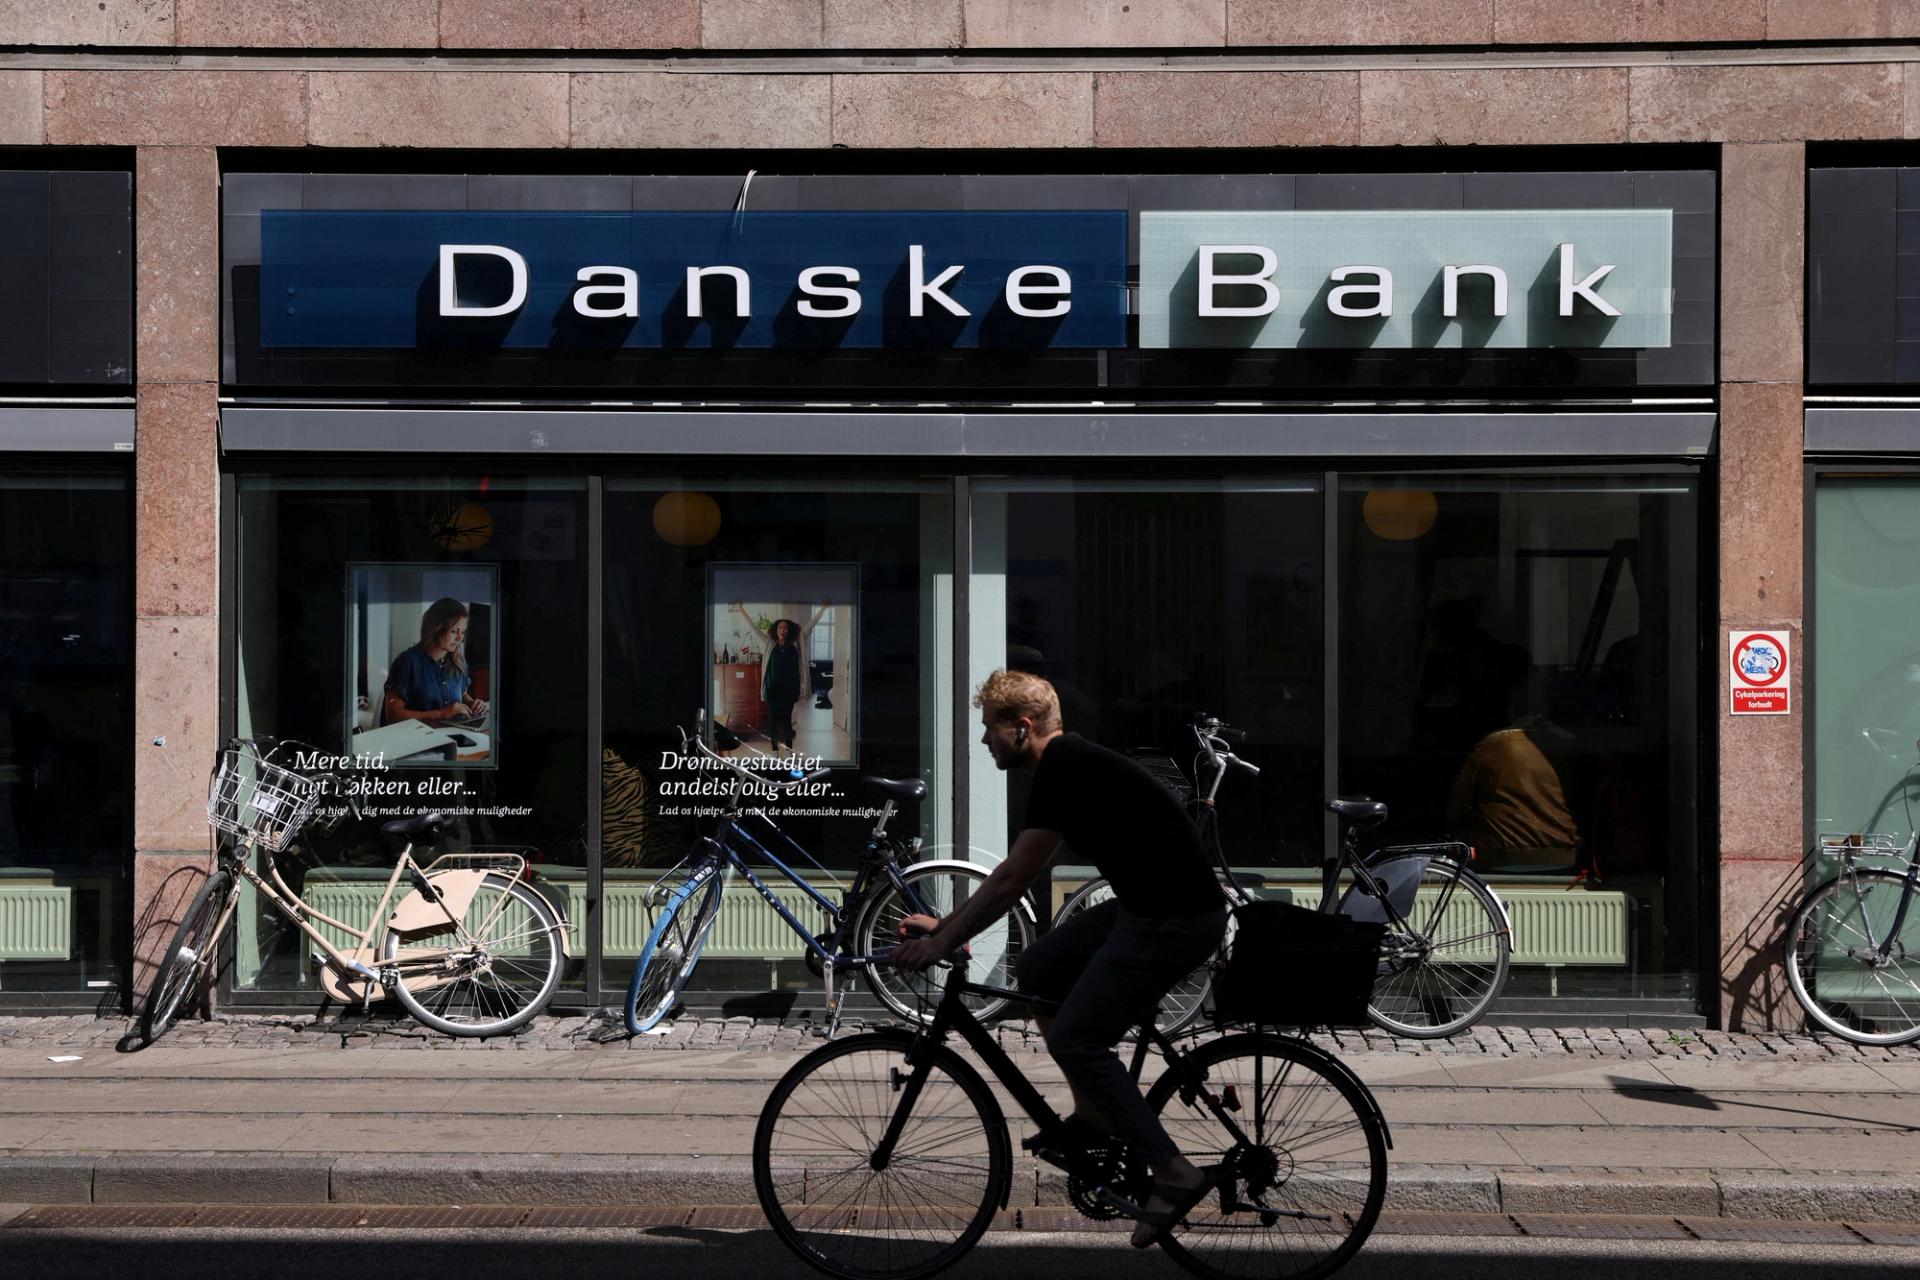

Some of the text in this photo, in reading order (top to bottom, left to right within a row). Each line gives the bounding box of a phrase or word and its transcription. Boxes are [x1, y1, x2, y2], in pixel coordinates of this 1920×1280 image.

[439, 243, 1624, 318] Danske Bank
[1735, 690, 1785, 700] Cykelparkering
[1748, 700, 1772, 709] forbudt
[293, 751, 390, 773] Mere tid,
[417, 776, 477, 796] eller...
[315, 807, 327, 816] os
[361, 804, 378, 818] dig
[379, 805, 401, 816] med
[402, 805, 415, 816] de
[476, 805, 533, 818] muligheder
[659, 805, 679, 816] Lad
[680, 806, 692, 816] os
[768, 806, 781, 817] de
[782, 806, 841, 817] økonomiske
